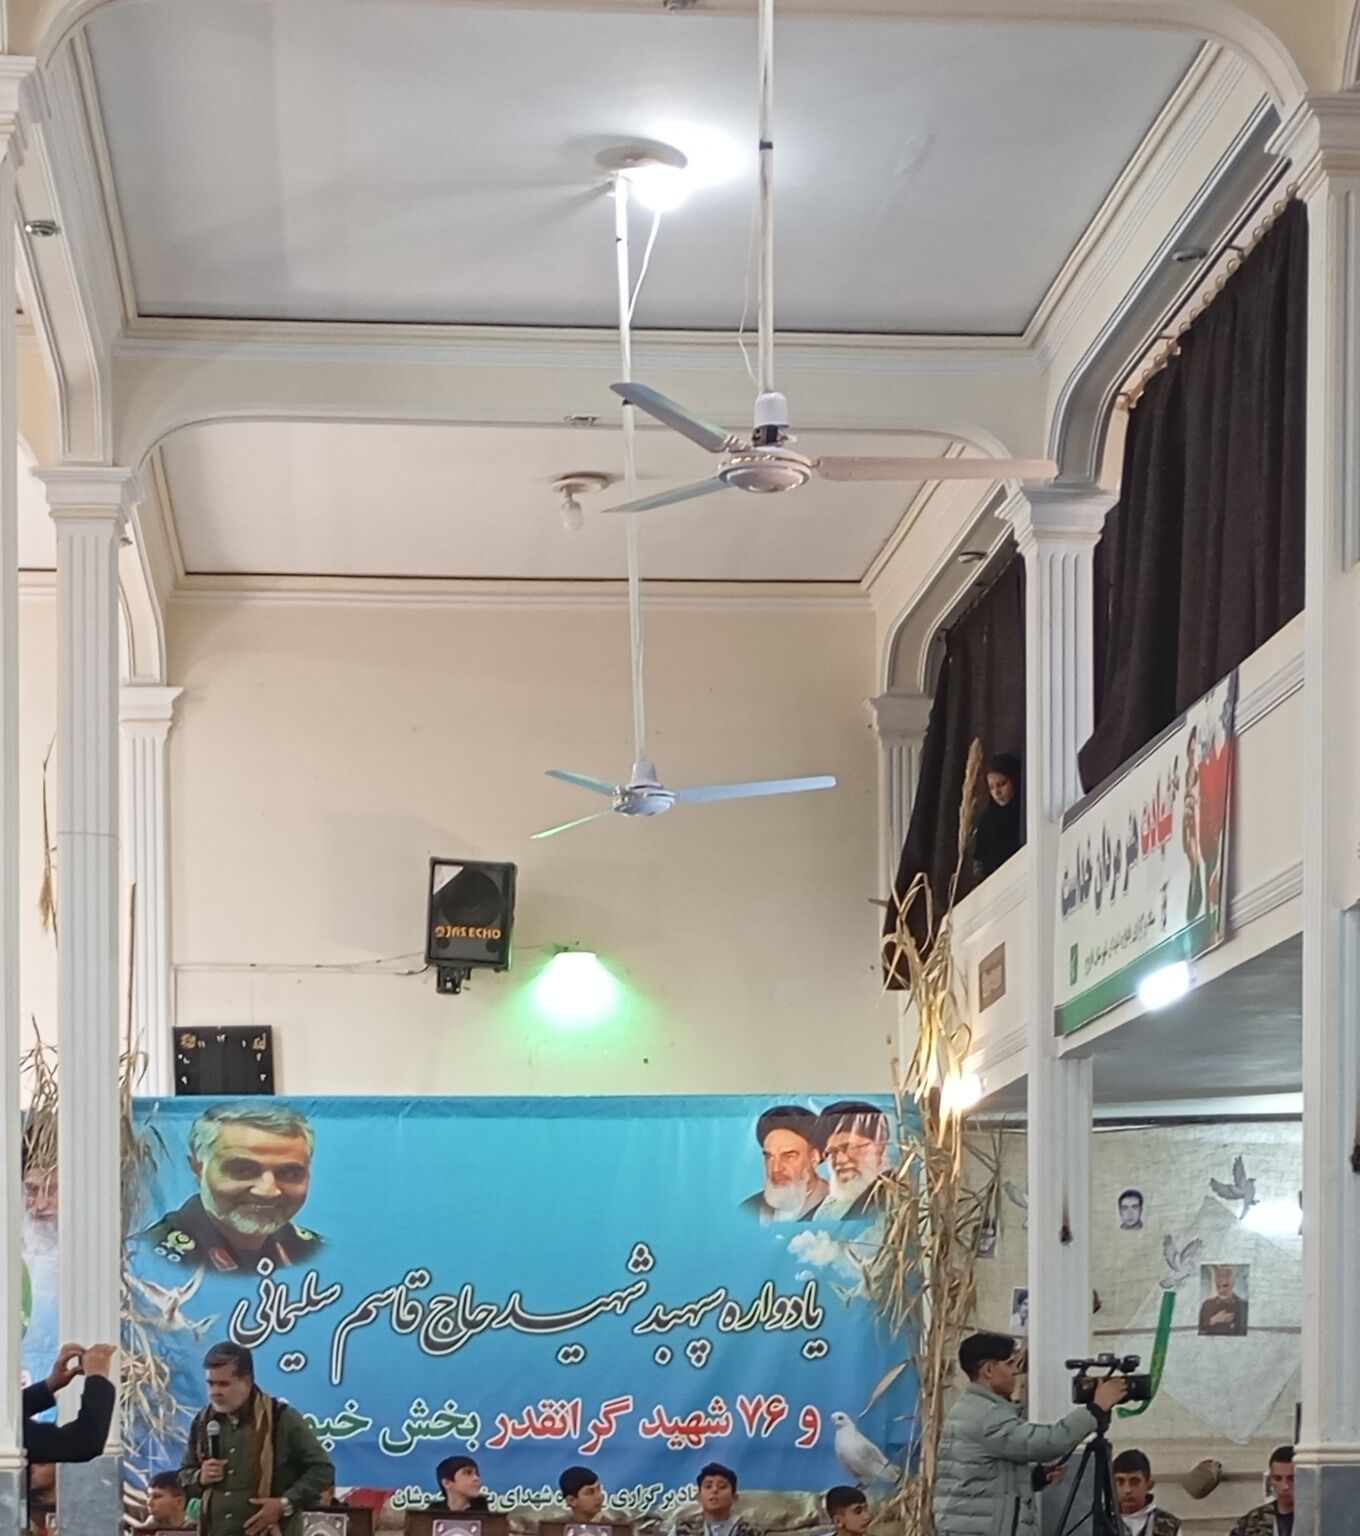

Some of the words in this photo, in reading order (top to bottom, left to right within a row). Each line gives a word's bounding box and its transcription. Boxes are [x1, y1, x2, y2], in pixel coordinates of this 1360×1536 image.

[228, 1257, 343, 1372] سلیمانی
[329, 1266, 431, 1385] قاسم
[420, 1284, 498, 1355] حاج
[491, 1242, 655, 1364] شهید
[632, 1286, 728, 1368] سپهبد
[719, 1280, 828, 1360] یادواره
[379, 1397, 482, 1456] بخش
[638, 1396, 733, 1448] شهید
[736, 1394, 789, 1437] ۷۶
[795, 1402, 823, 1450] و
[501, 1485, 554, 1511] شهدای
